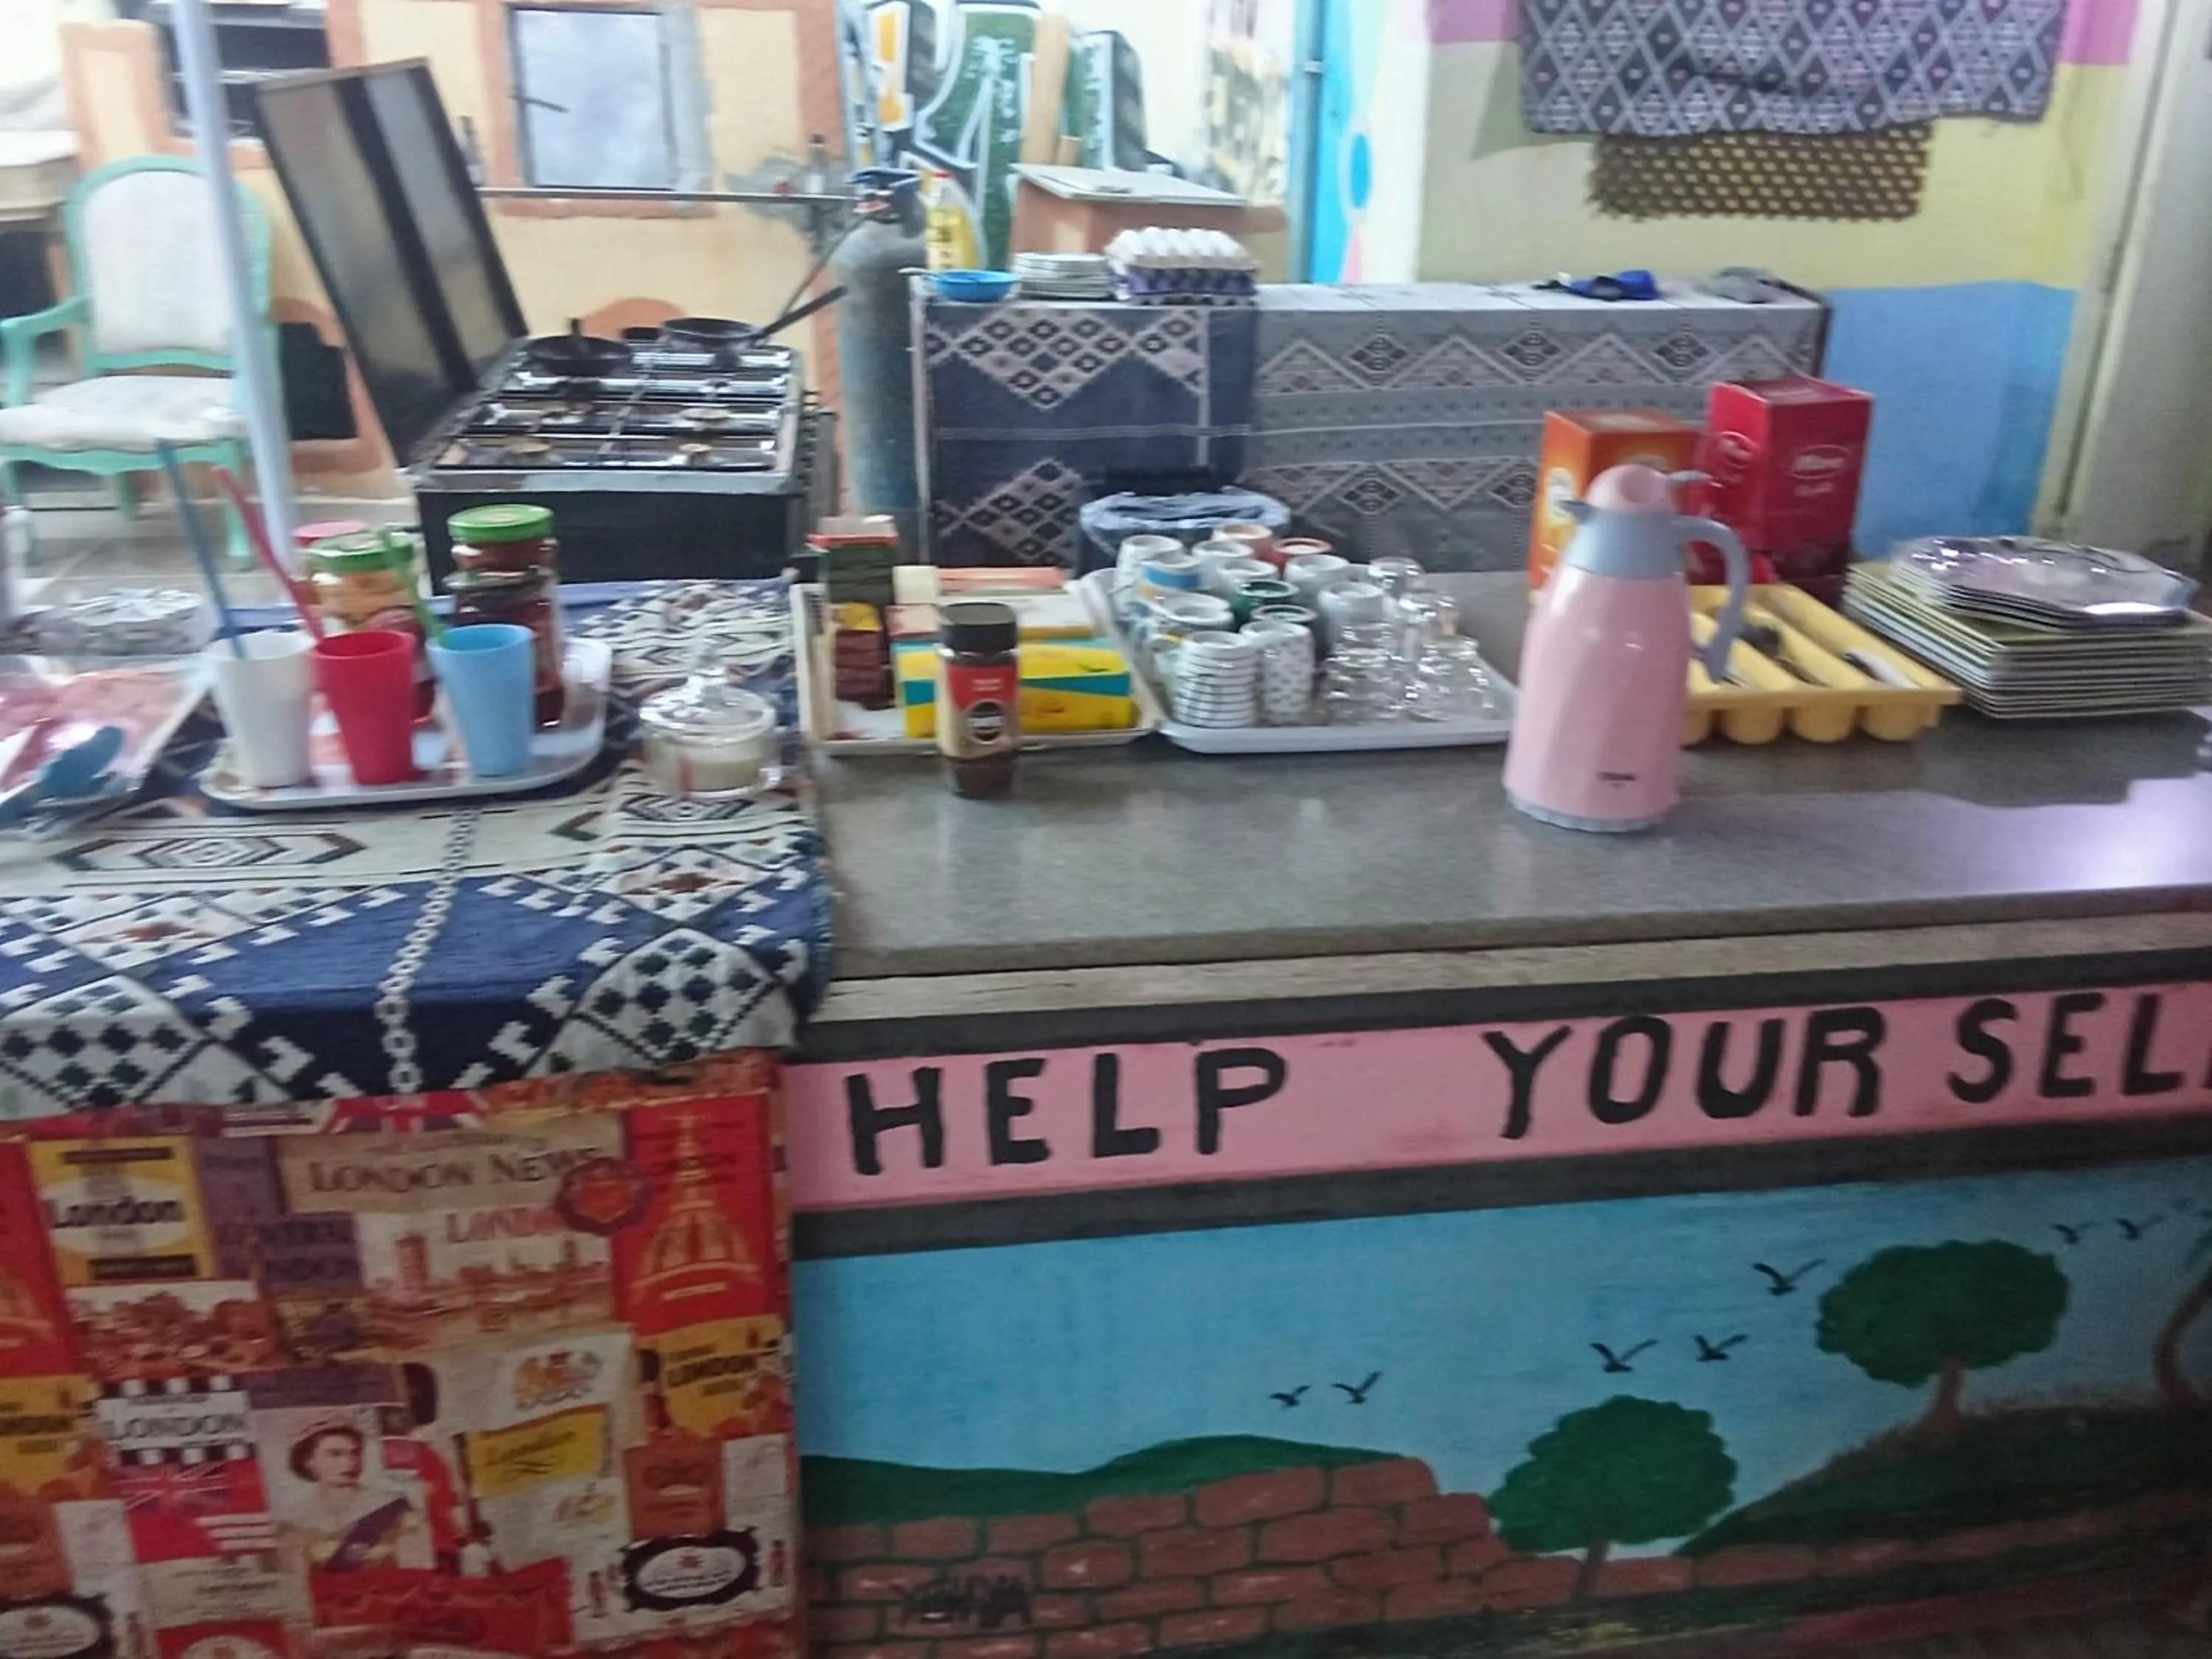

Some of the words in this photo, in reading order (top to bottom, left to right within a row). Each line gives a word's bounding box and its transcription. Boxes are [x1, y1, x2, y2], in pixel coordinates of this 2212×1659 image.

[844, 1046, 1287, 1176] HELP
[1480, 1006, 1887, 1140] YOUR
[1947, 990, 2212, 1104] SEL
